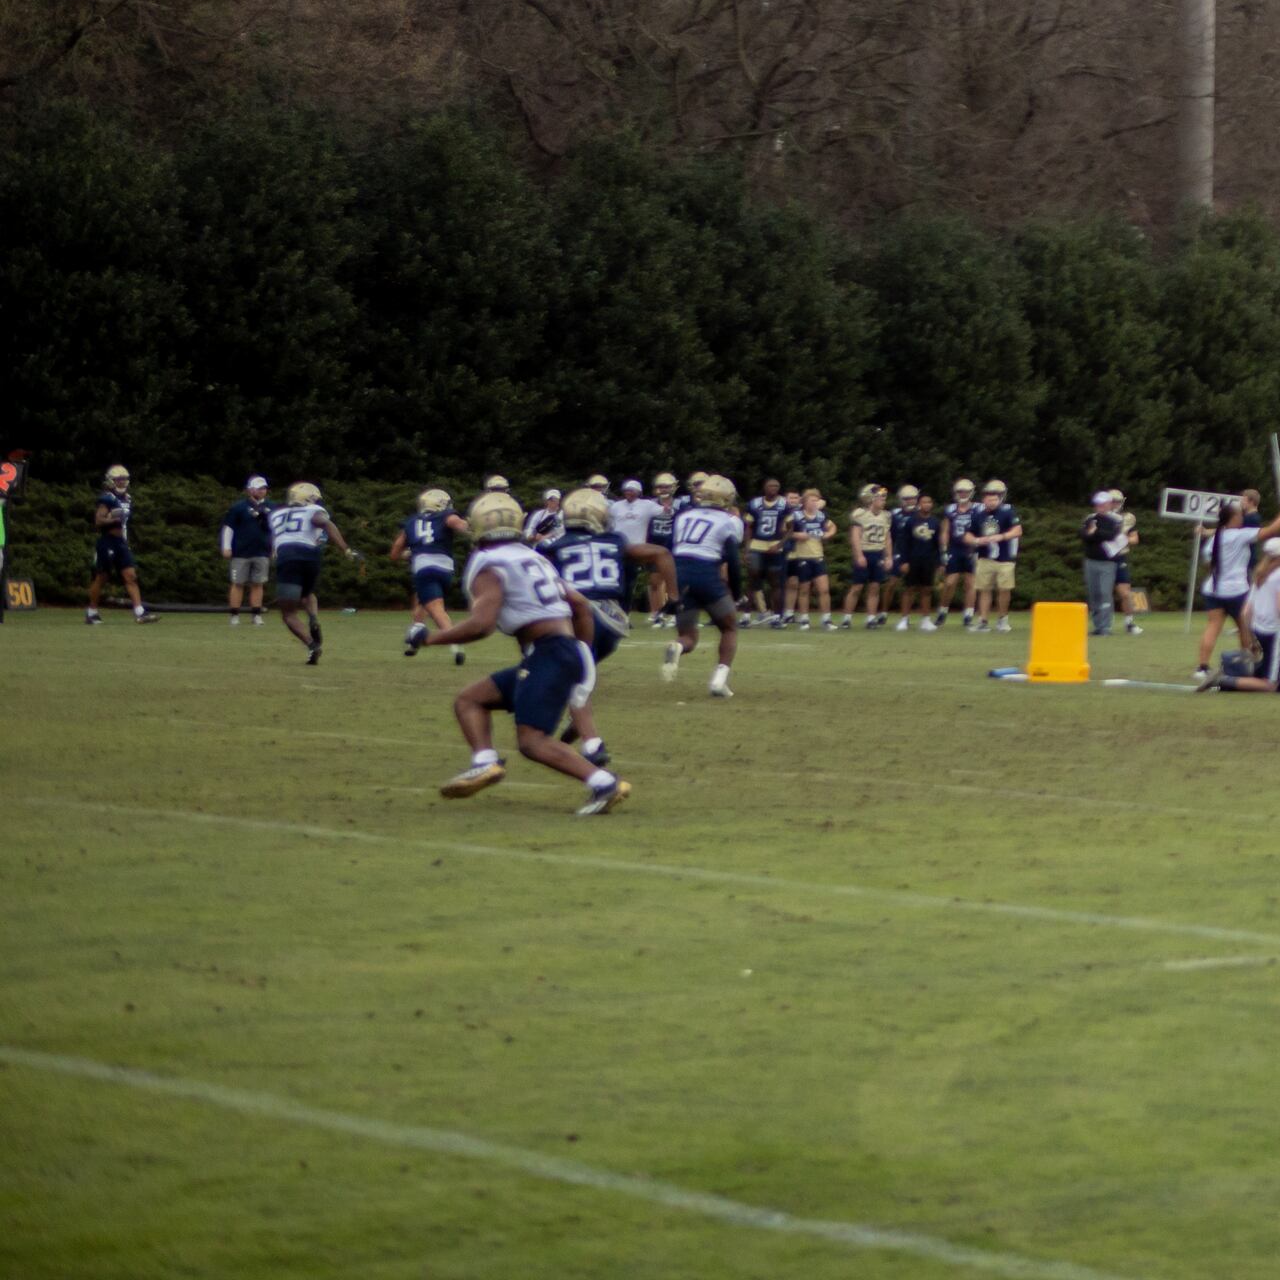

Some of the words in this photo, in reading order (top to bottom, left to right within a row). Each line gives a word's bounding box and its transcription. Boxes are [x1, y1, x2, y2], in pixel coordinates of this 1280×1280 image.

[272, 509, 307, 536] 25
[414, 519, 435, 545] 4
[678, 517, 714, 545] 10
[557, 541, 620, 590] 26
[8, 581, 33, 607] 50
